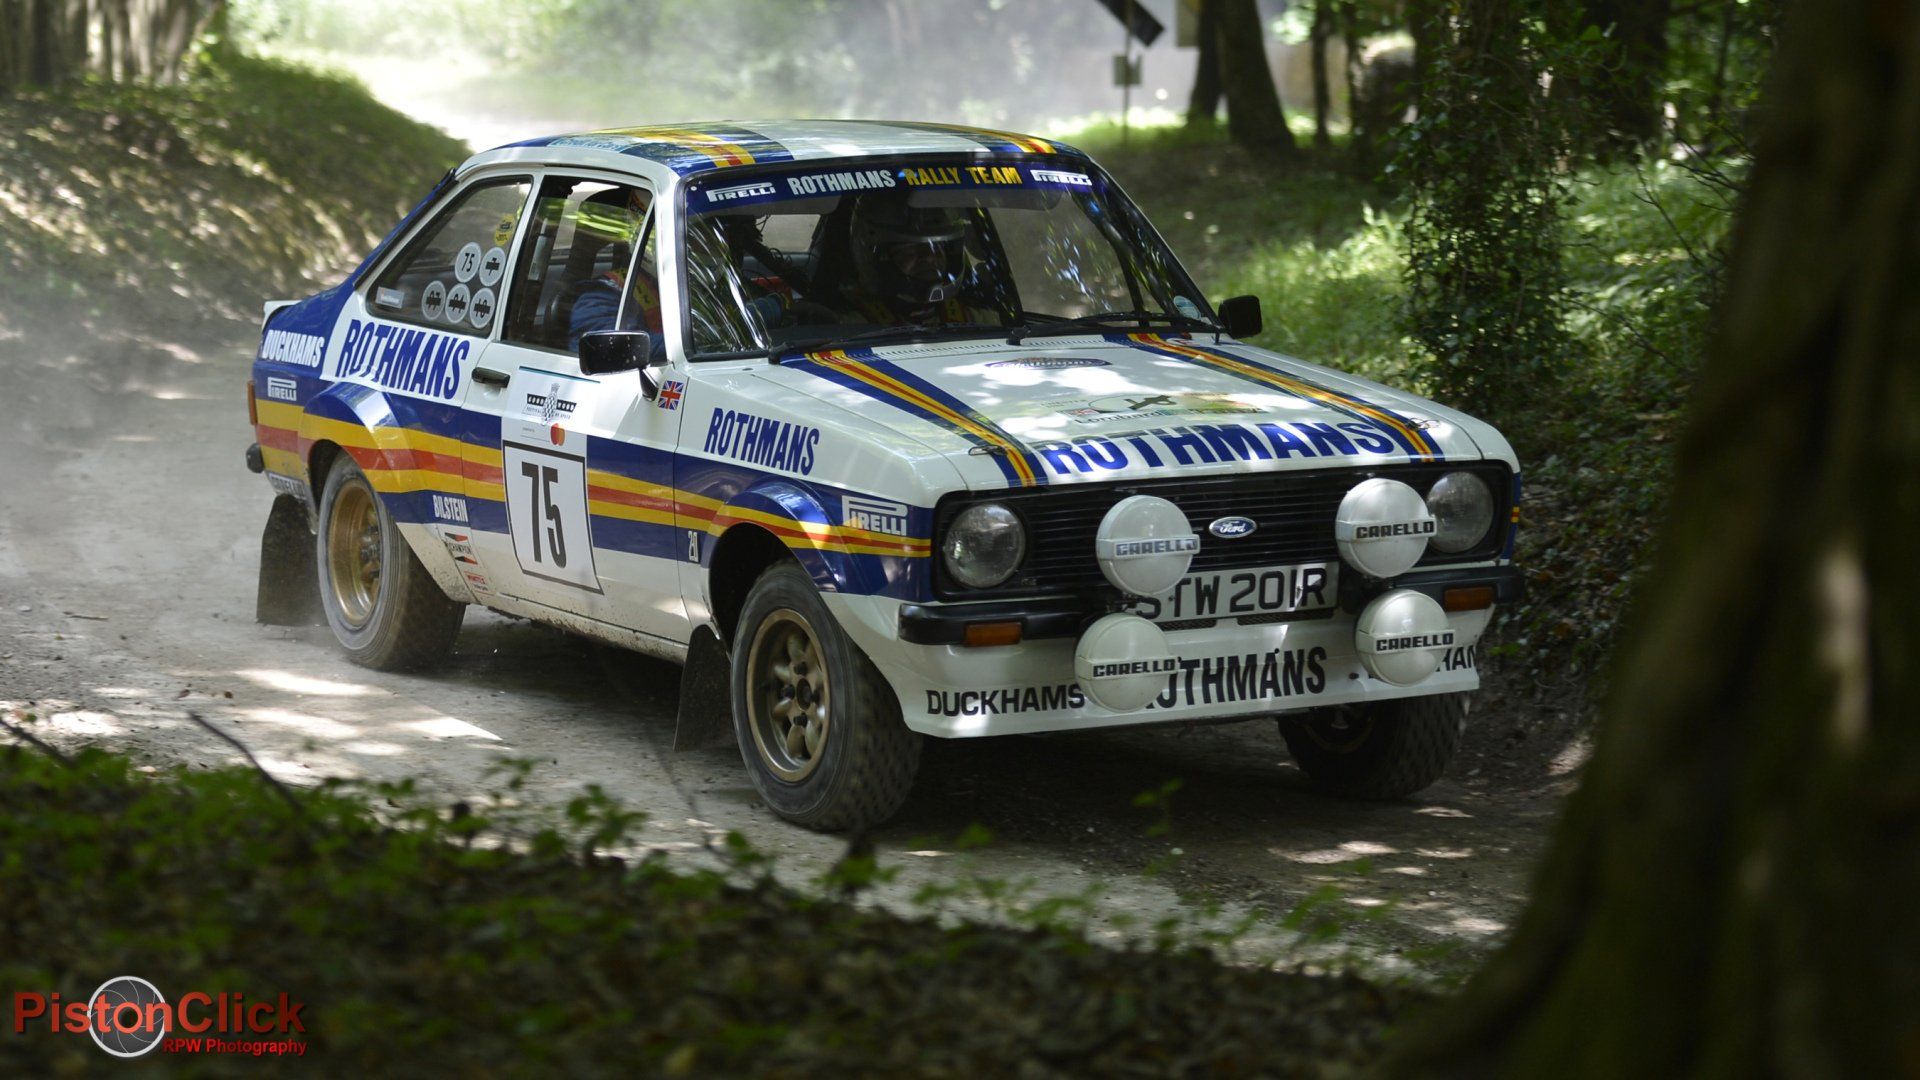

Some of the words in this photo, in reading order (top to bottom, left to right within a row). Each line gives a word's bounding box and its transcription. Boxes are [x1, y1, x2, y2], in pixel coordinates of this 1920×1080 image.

[706, 182, 776, 202] PIRELLI
[787, 169, 896, 195] ROTHMANS
[903, 167, 962, 186] RALLY
[965, 166, 1023, 185] TEAM
[461, 252, 476, 273] 75
[262, 329, 325, 368] DUCKHAMS
[335, 318, 470, 400] ROTHMANS
[267, 376, 297, 402] PIRELLI
[703, 407, 820, 476] ROTHMANS
[1025, 422, 1395, 475] ROTHMANS
[433, 494, 468, 523] BILSTEIN
[521, 461, 567, 569] 75
[841, 495, 908, 537] PIRELLI
[1215, 520, 1246, 534] Ford
[1356, 521, 1435, 539] CARELLO
[1115, 538, 1198, 557] CARELLO
[1228, 566, 1328, 614] 201R
[1375, 633, 1454, 652] CARELLO
[1092, 658, 1176, 678] CARELLO
[1145, 646, 1327, 709] OTHMANS
[925, 684, 1085, 717] DUCKHAMS
